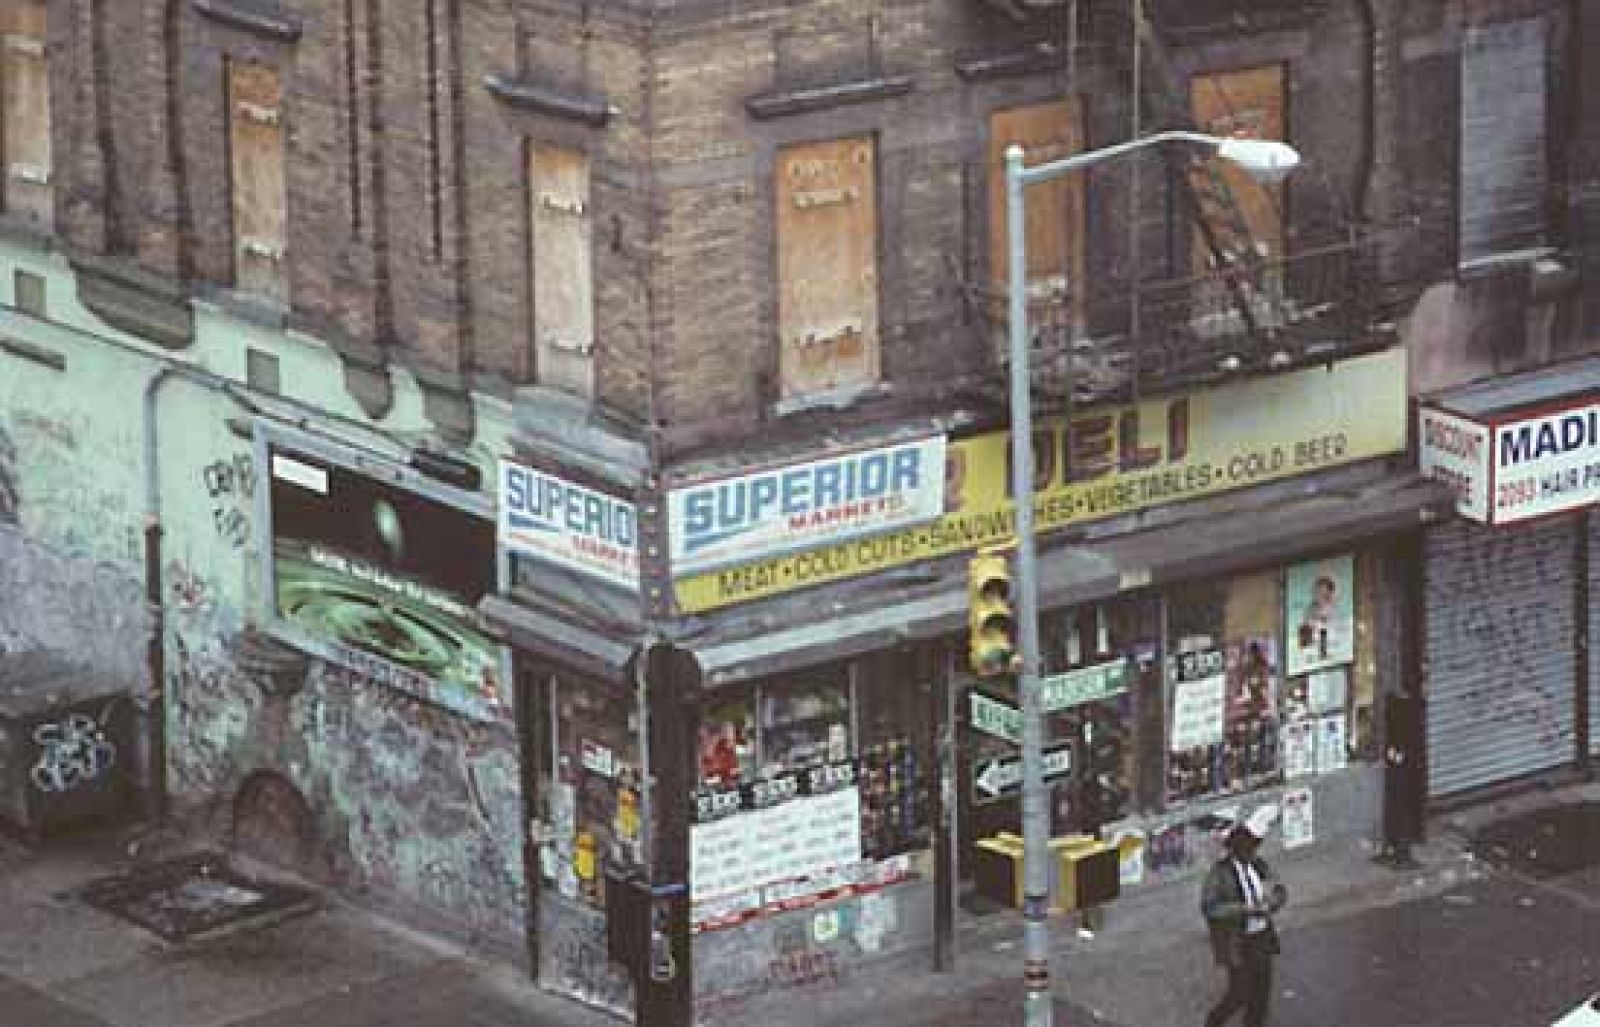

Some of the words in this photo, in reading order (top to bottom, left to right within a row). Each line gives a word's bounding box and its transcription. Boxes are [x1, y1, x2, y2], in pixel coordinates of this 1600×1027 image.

[684, 447, 920, 535] SUPERIOR
[720, 563, 778, 596] MEAT
[796, 545, 854, 580] COLD
[858, 532, 913, 567] CUTS
[1085, 462, 1212, 512] VEGETABLES
[1227, 446, 1285, 484] COLD
